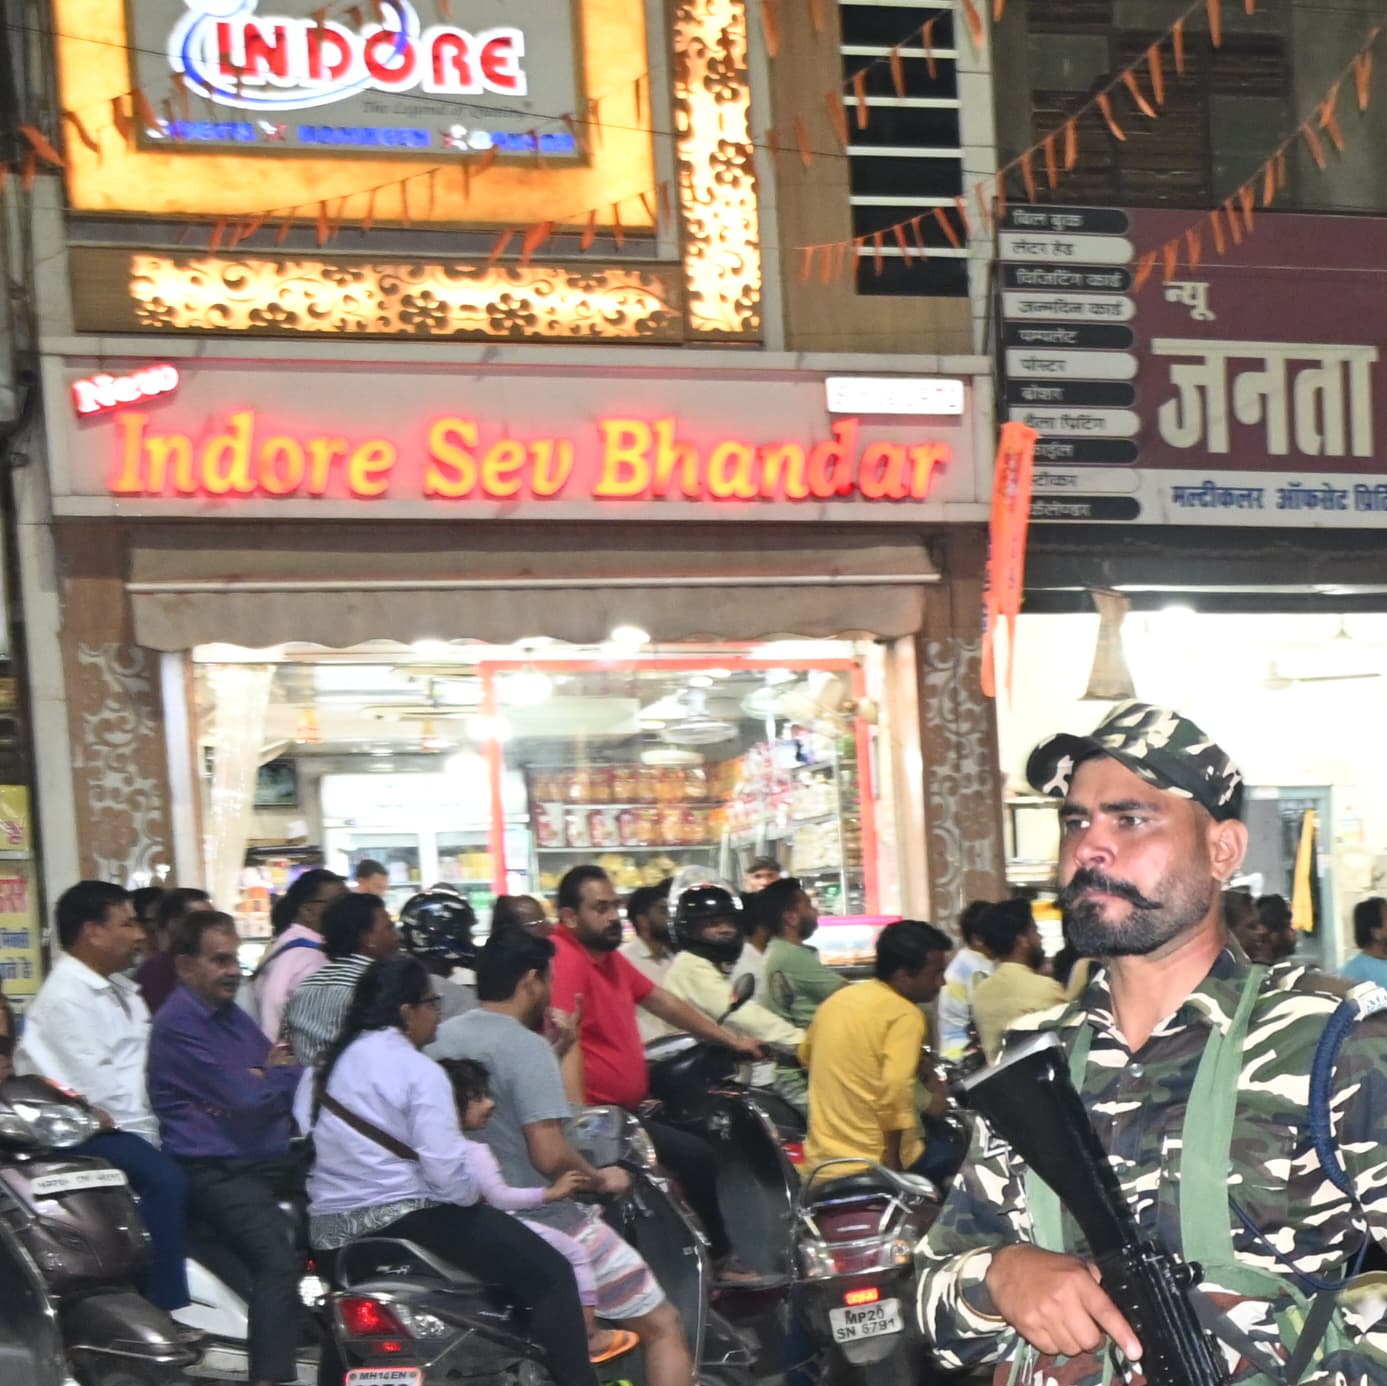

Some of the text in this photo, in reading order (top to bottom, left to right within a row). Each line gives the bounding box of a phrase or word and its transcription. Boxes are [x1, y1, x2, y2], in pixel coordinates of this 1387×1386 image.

[212, 17, 523, 93] INDORE
[1162, 280, 1216, 321] न्यू
[1151, 337, 1380, 458] जनता
[109, 409, 398, 497] Indore
[423, 416, 574, 499] Sev
[592, 416, 951, 501] Bhandar
